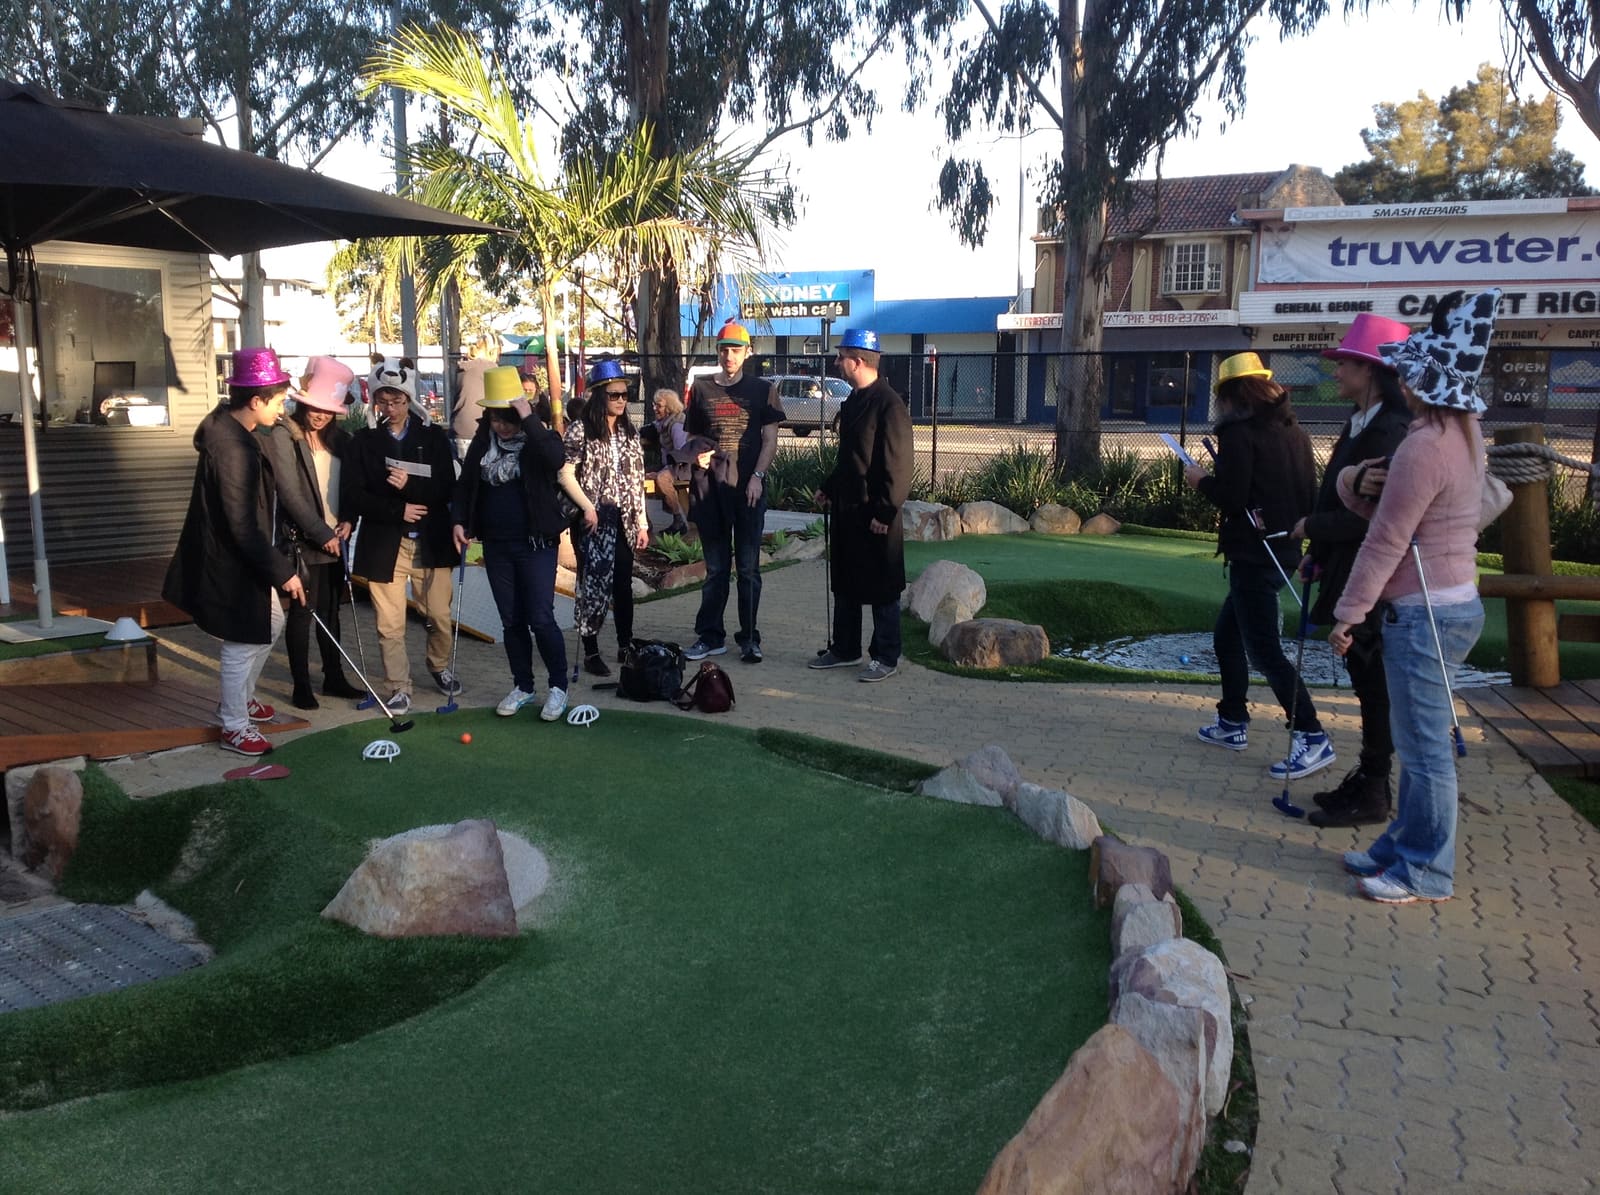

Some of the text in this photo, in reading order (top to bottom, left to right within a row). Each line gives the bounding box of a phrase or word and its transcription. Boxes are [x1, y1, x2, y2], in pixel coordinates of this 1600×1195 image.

[1372, 207, 1416, 218] SMASH
[1418, 205, 1469, 216] REPAIRS
[1328, 232, 1600, 267] truwater.
[745, 306, 768, 317] cr
[771, 303, 808, 316] wash
[1275, 291, 1600, 316] GENERAL GEORGE CAT RIG
[1272, 332, 1336, 342] CARPET RIGHT
[1502, 362, 1546, 373] OPEN
[1503, 391, 1540, 403] DAYS
